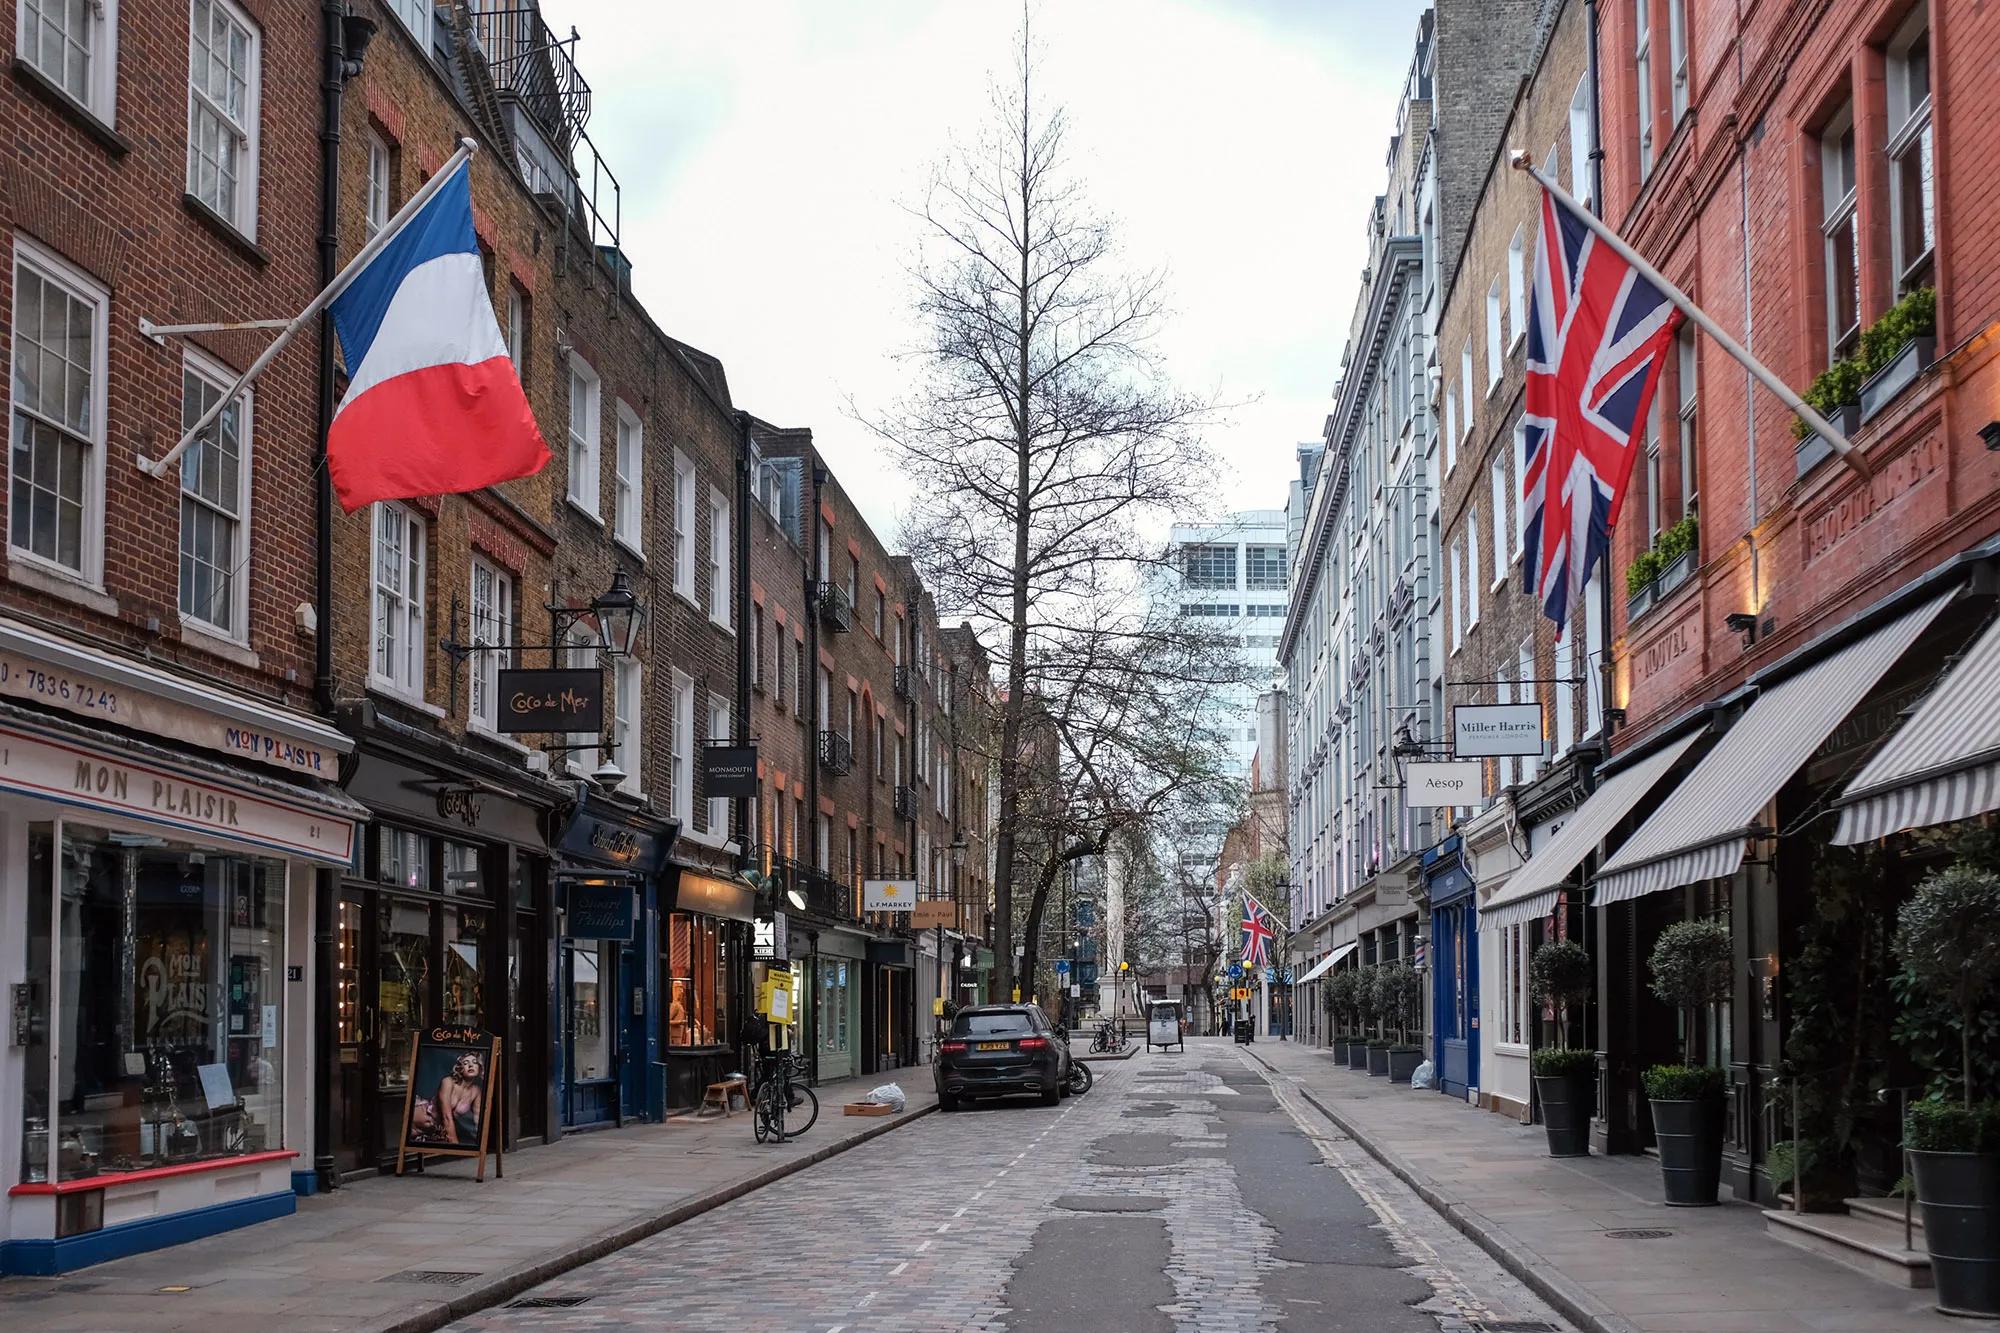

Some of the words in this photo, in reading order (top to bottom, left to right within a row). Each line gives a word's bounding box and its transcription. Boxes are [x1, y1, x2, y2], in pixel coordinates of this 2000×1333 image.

[1645, 625, 1688, 678] NOUVEL
[27, 669, 70, 699] 7836
[76, 684, 117, 713] 7243
[510, 692, 541, 713] Coco
[545, 693, 557, 707] de
[561, 688, 589, 713] Mer
[1461, 722, 1496, 732] Miller
[1499, 721, 1536, 731] Harris
[225, 728, 259, 752] MON
[264, 737, 320, 771] PLAISIR
[75, 759, 128, 800] MON
[152, 780, 238, 825] PLAISIR
[575, 911, 625, 930] Phillips
[937, 910, 953, 918] Paul
[169, 954, 201, 977] MON
[288, 969, 297, 979] 21
[431, 1027, 452, 1041] Coco
[462, 1027, 481, 1043] Mer
